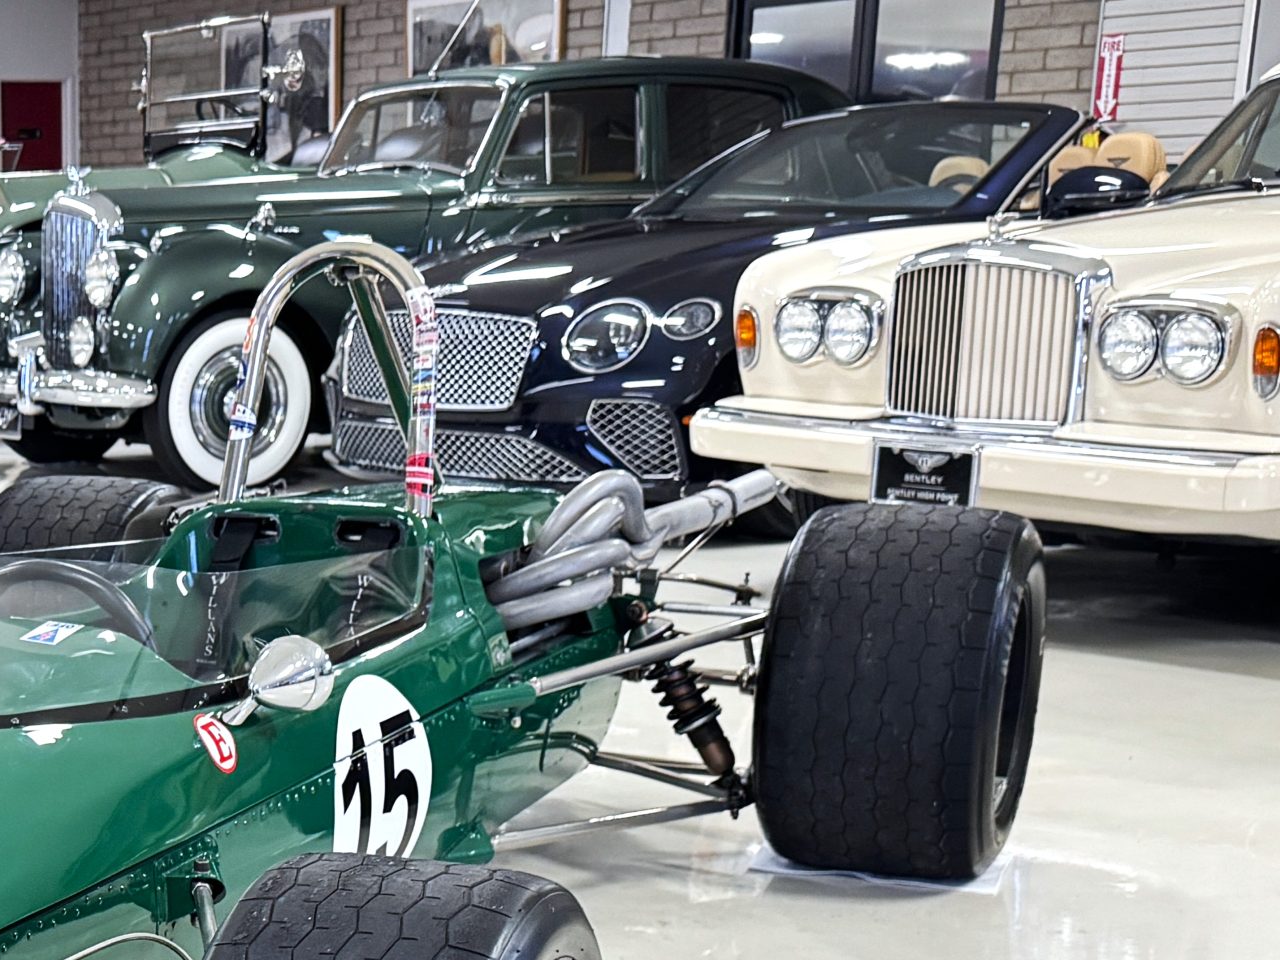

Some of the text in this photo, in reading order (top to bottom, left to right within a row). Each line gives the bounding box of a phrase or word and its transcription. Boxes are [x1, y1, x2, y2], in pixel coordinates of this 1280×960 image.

[1103, 40, 1122, 53] FIRE
[888, 488, 916, 499] BENTLEY
[917, 490, 935, 501] HIGH
[903, 473, 944, 485] BENTLEY
[204, 572, 229, 657] WILLANS
[345, 574, 372, 638] WILLA
[341, 709, 419, 858] 15
